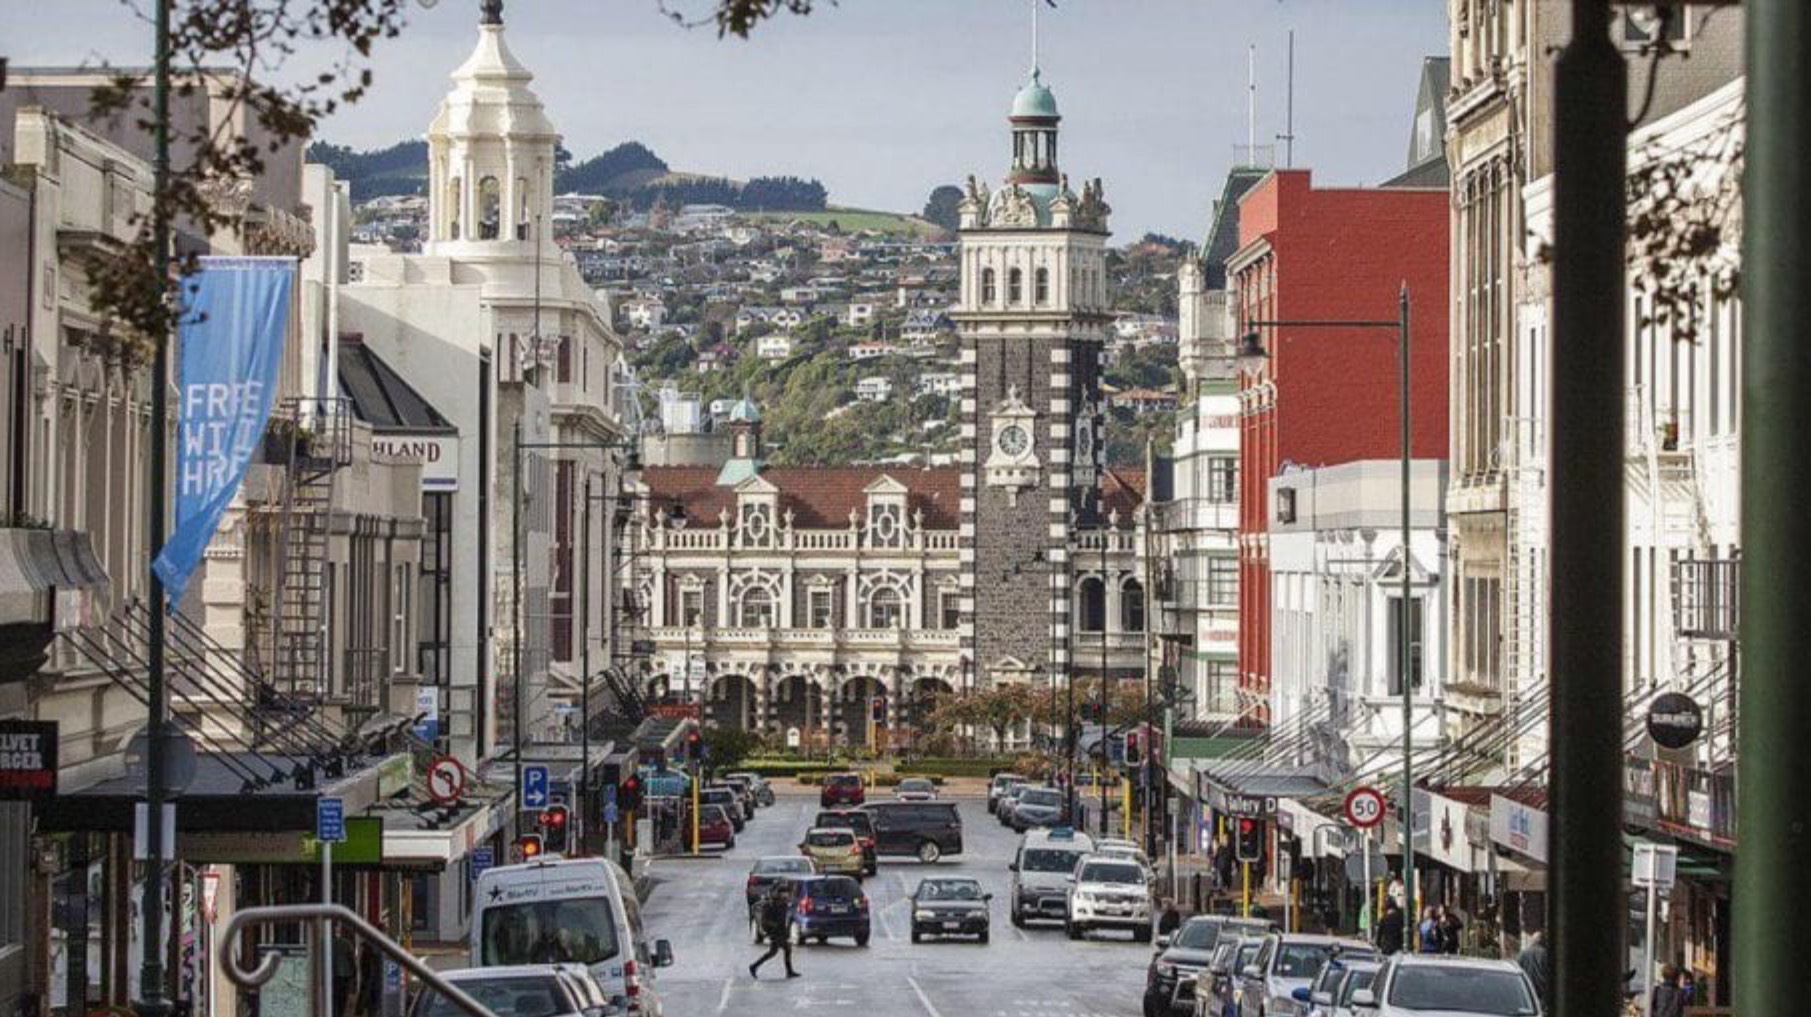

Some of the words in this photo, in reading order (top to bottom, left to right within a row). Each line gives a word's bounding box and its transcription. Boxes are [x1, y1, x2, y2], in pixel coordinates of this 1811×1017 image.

[186, 380, 264, 418] FREE
[0, 733, 40, 751] LVET
[529, 771, 542, 786] P
[1355, 800, 1377, 816] 50
